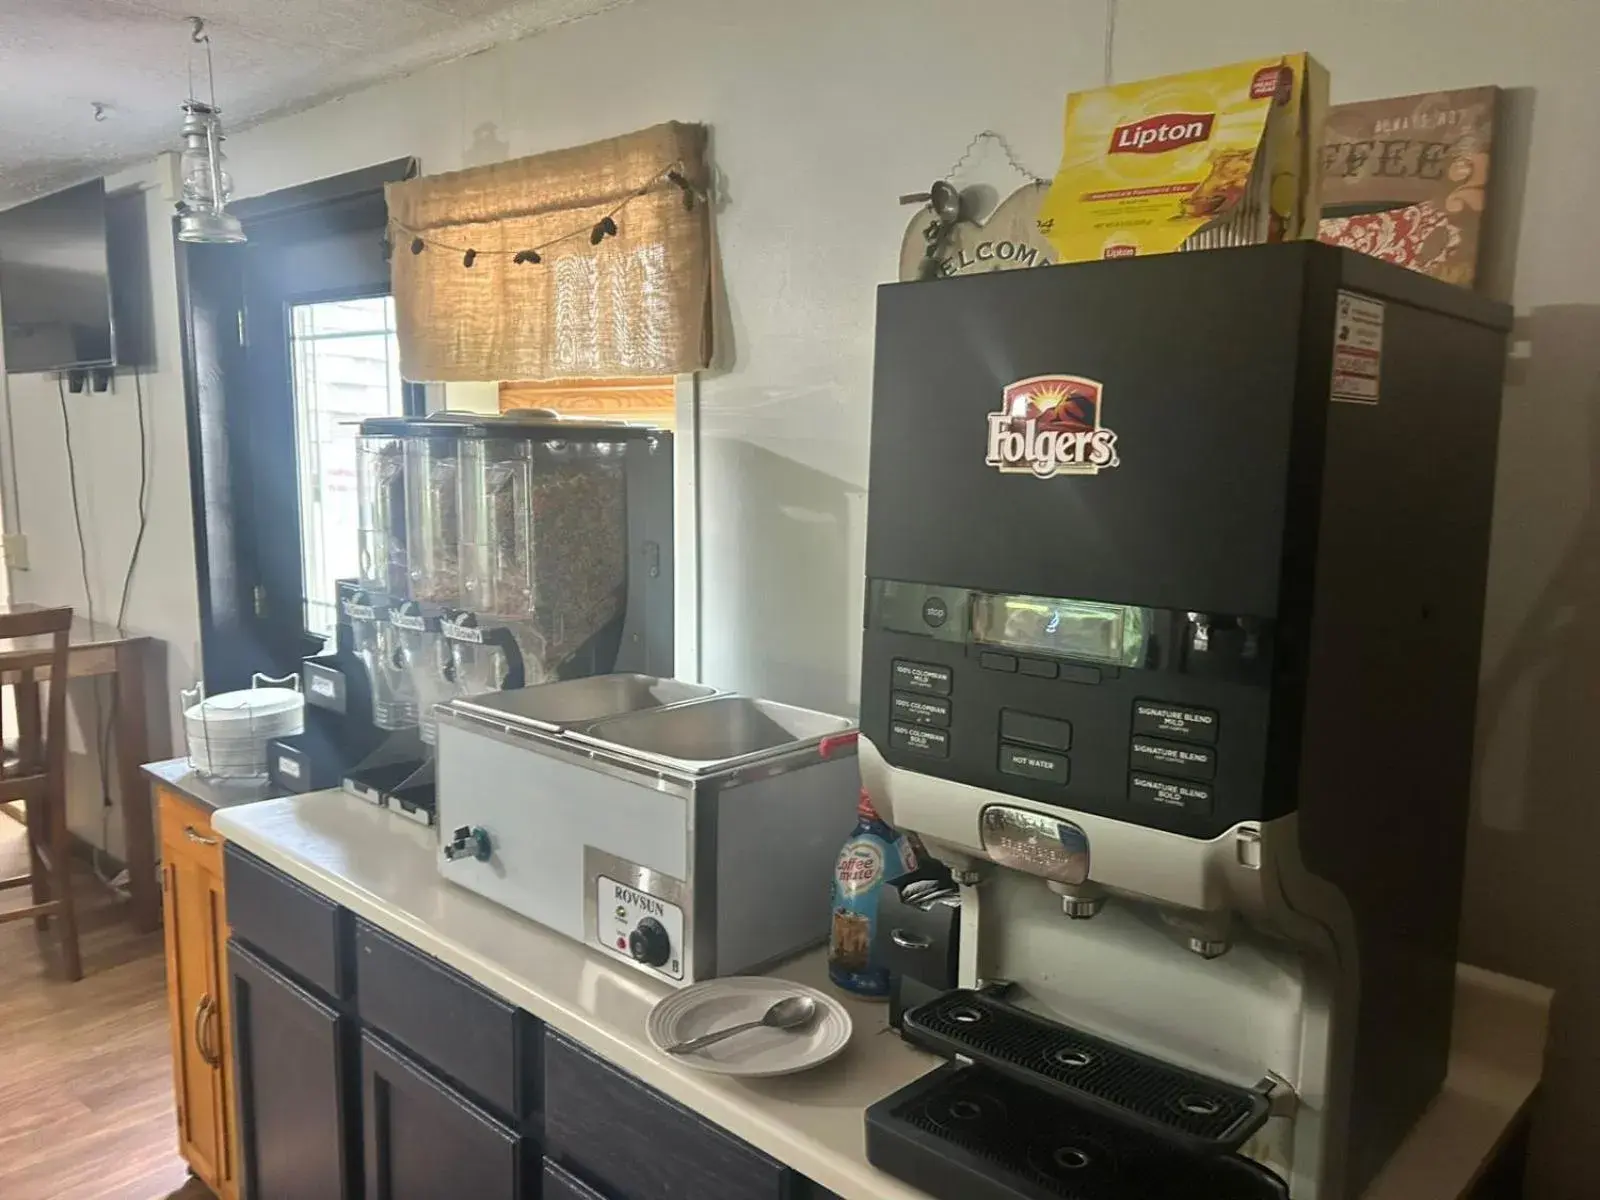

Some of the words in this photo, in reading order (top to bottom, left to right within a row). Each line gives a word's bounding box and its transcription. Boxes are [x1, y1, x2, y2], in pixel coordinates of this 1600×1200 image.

[1118, 121, 1204, 149] Lipton
[988, 414, 1112, 474] Folgers
[927, 608, 945, 618] stop
[1138, 707, 1183, 719] SIGNATURE
[1184, 713, 1212, 724] BLEND
[1164, 718, 1185, 727] MILD
[1134, 744, 1178, 757] SIGNATURE
[1179, 751, 1208, 763] BLEND
[1012, 756, 1027, 764] HOT
[1028, 759, 1055, 770] WATER
[1134, 778, 1178, 792] SIGNATURE
[1180, 787, 1208, 799] BLEND
[1158, 790, 1182, 801] BOLD
[614, 886, 664, 917] ROVSUN
